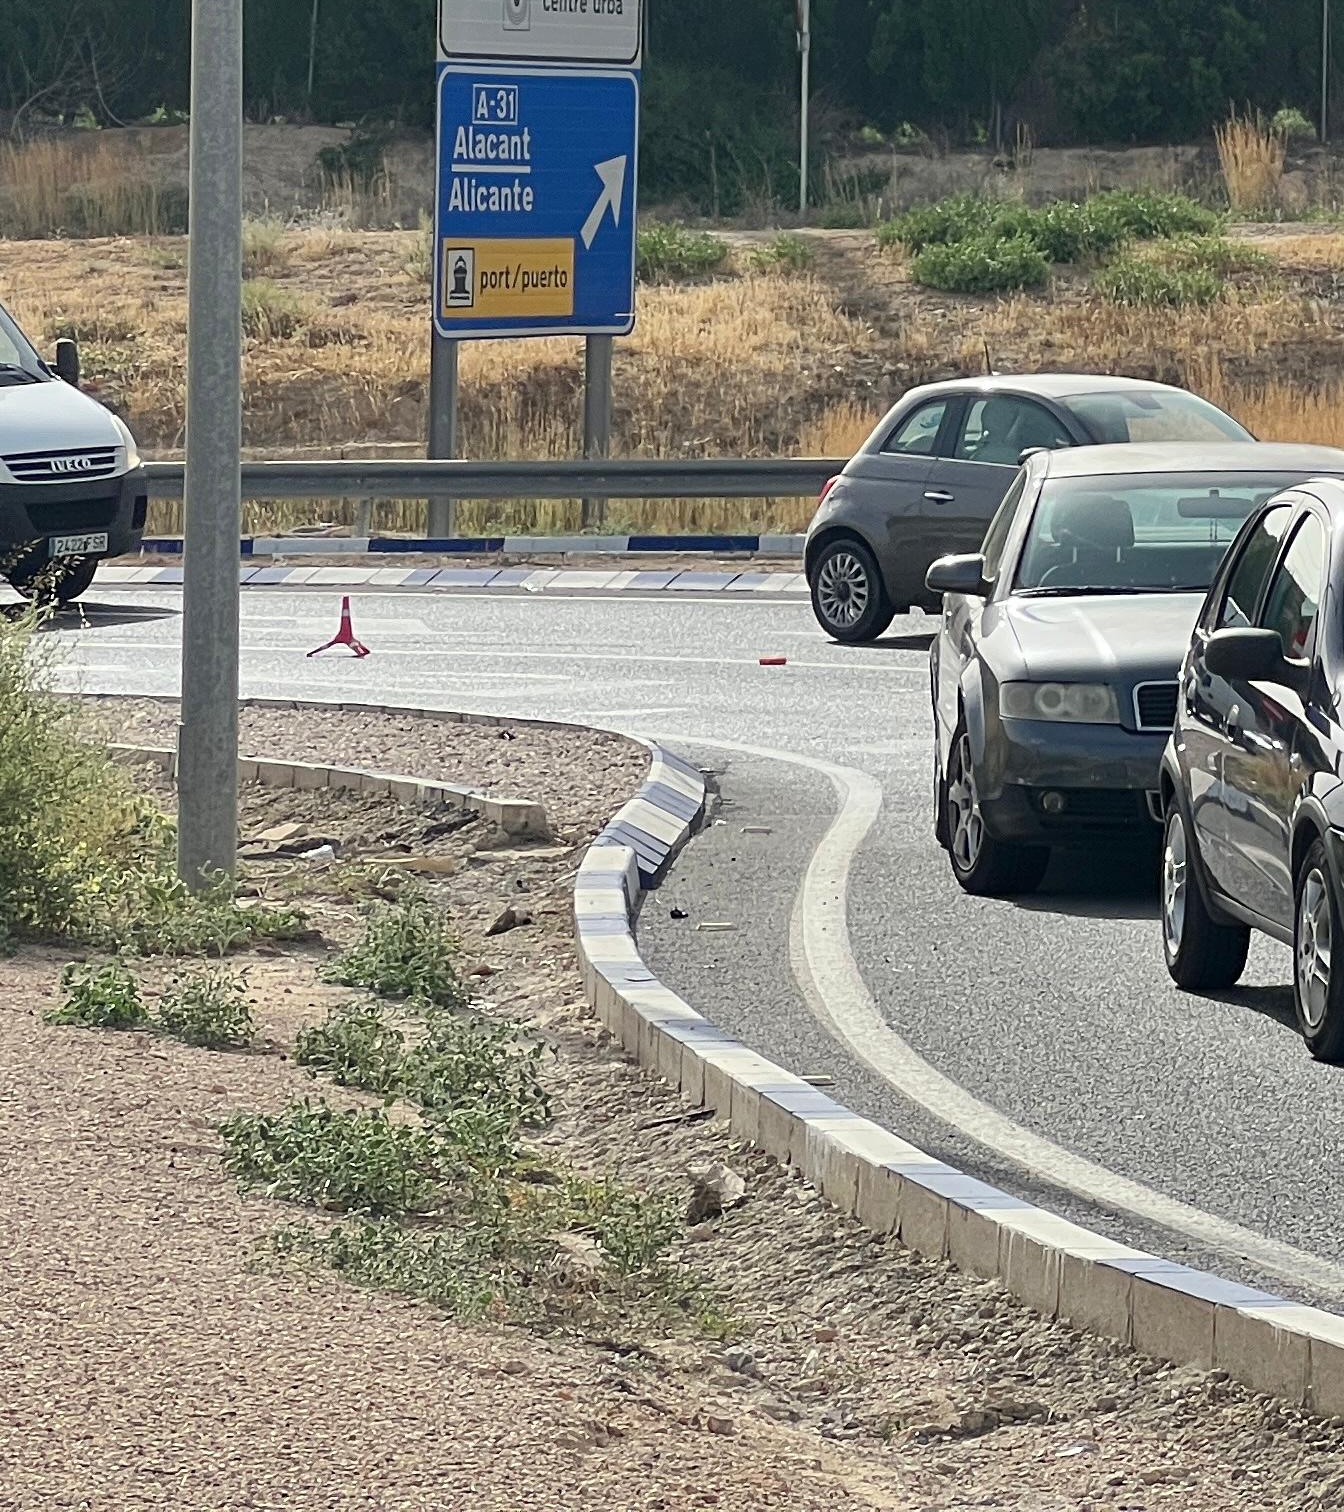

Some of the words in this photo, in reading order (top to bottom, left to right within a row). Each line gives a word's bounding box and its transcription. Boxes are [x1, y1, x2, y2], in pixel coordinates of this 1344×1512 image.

[476, 90, 515, 120] A-31
[453, 125, 531, 161] Alacant
[448, 176, 534, 212] Alicante
[479, 263, 568, 294] port/puerto
[50, 457, 92, 474] IVECO
